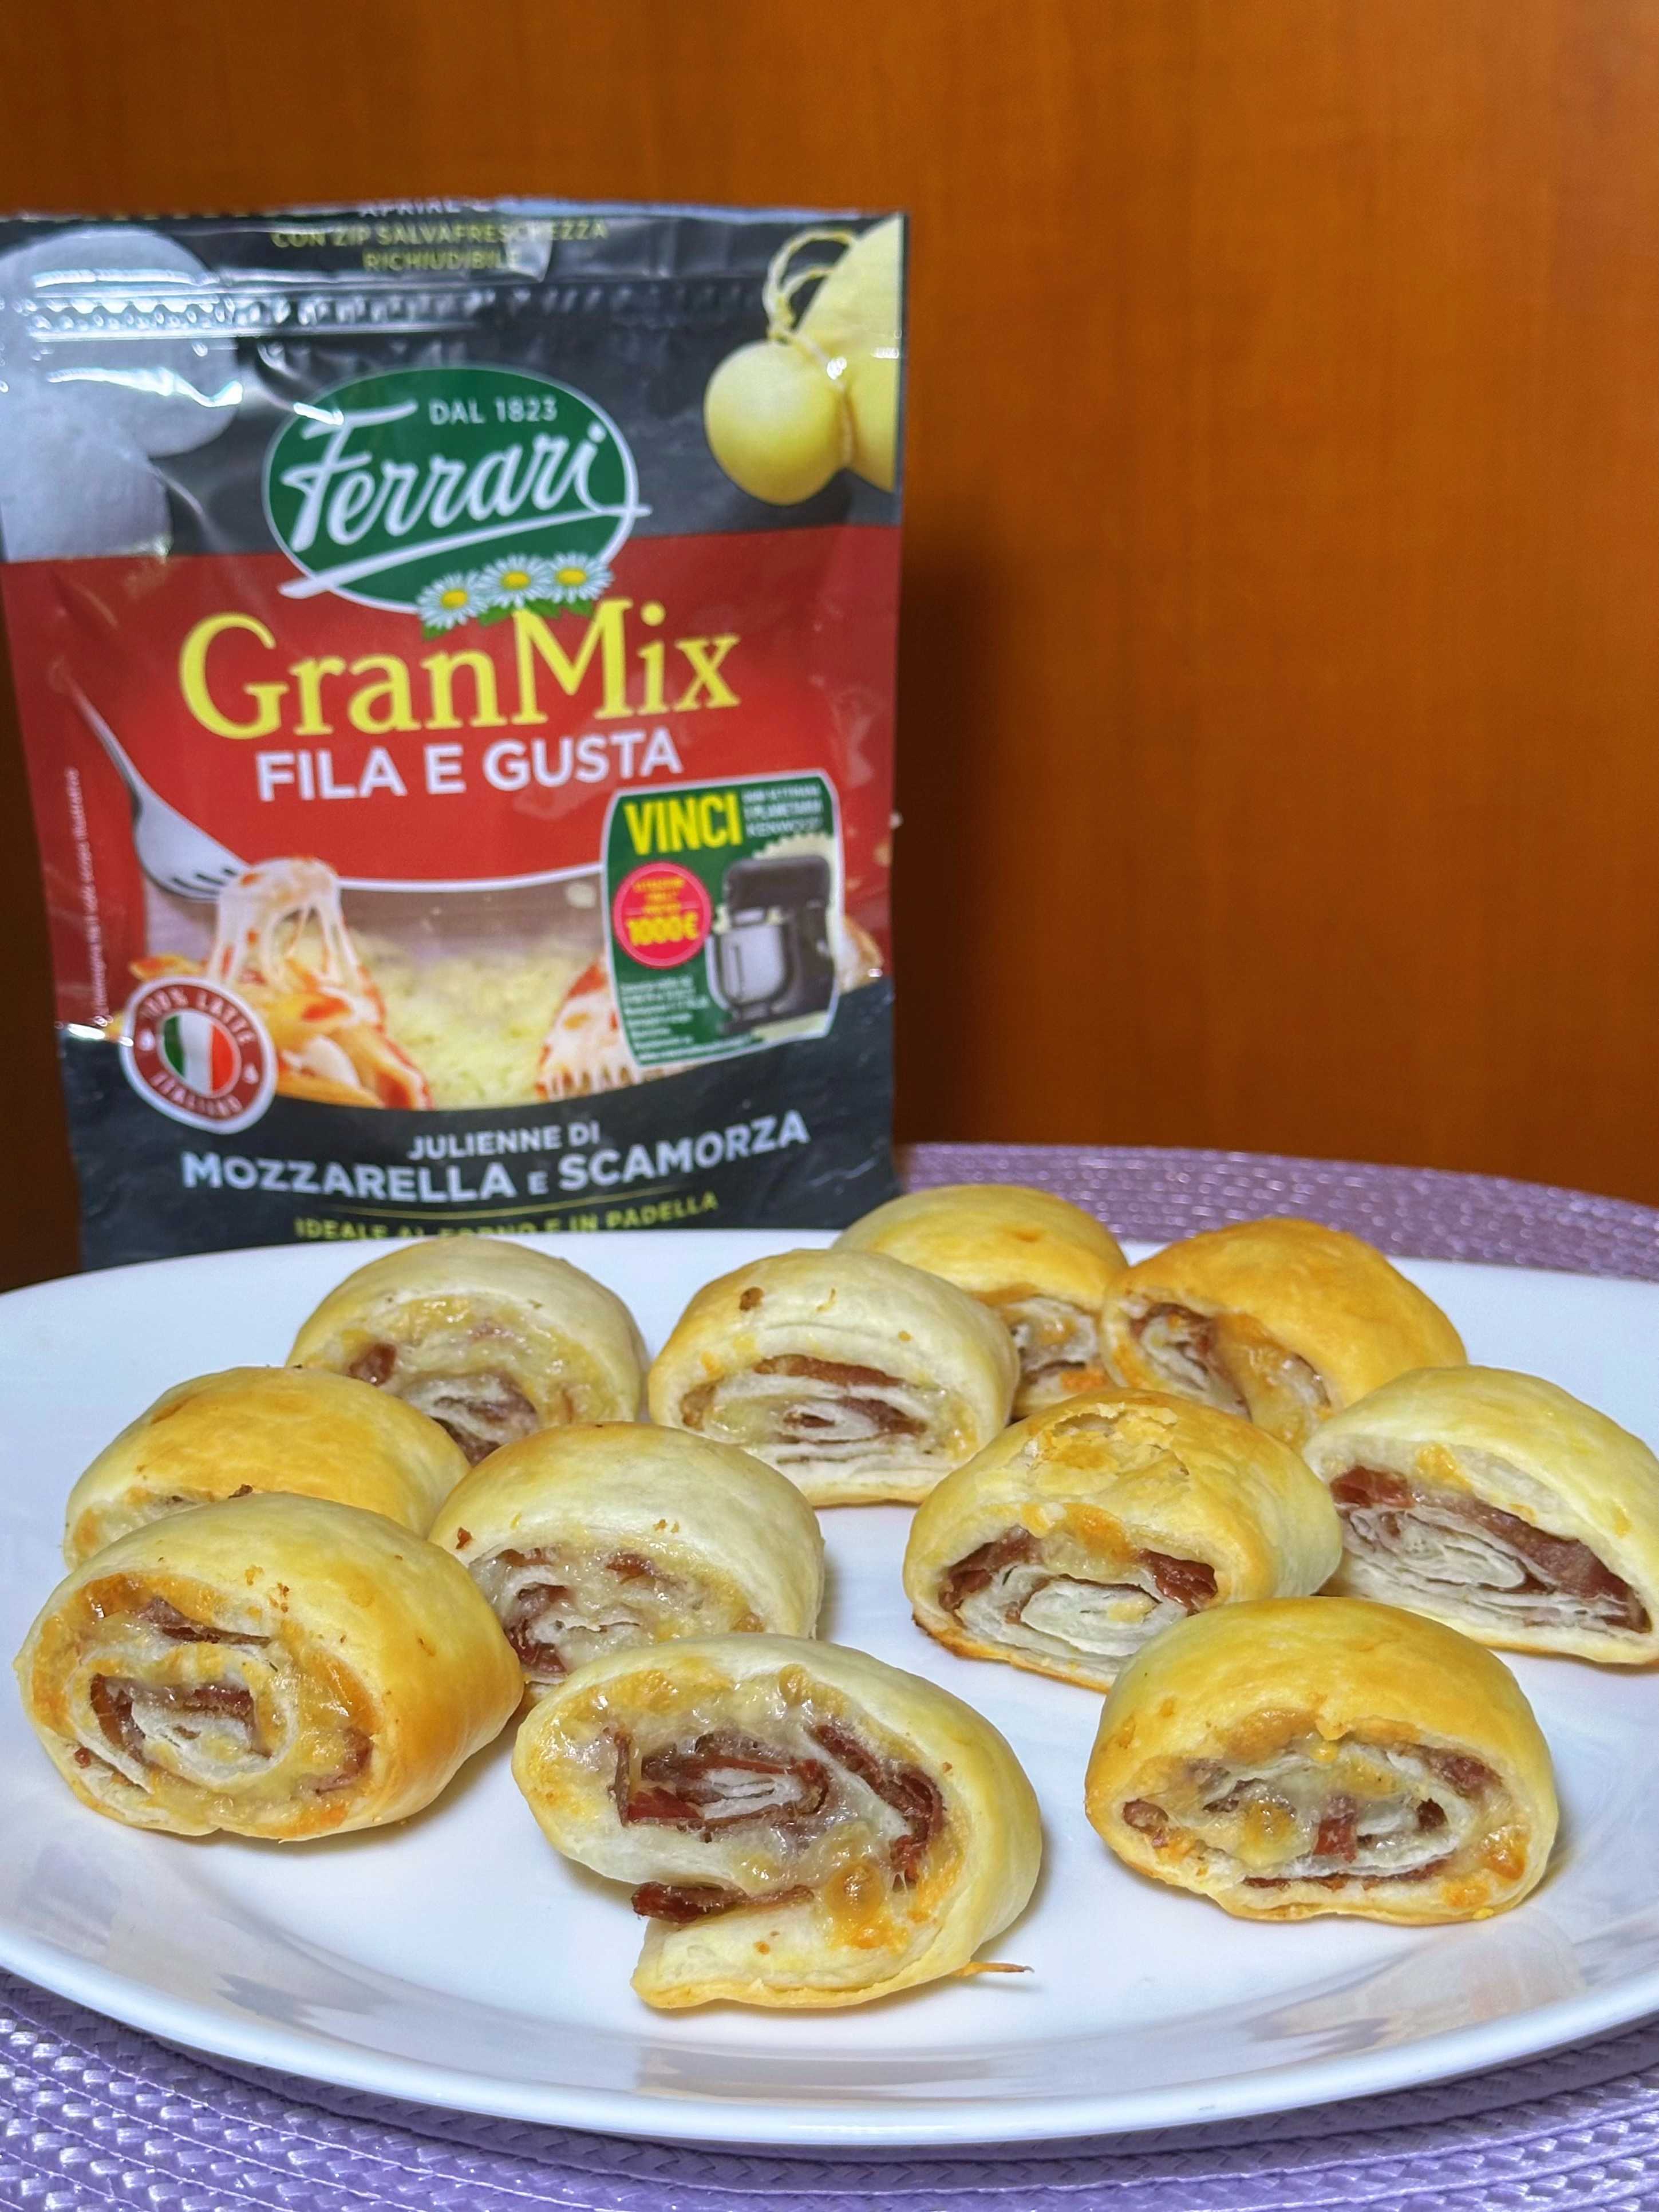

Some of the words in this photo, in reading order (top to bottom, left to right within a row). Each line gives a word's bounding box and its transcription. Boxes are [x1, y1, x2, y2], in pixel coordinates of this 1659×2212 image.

[270, 228, 325, 248] CON
[335, 224, 370, 246] ZIP
[429, 400, 485, 425] DAL
[495, 395, 558, 422] 1823
[279, 401, 635, 567] Ferrari
[178, 598, 742, 741] GranMix
[255, 746, 408, 803] FILA
[424, 743, 467, 795] E
[483, 726, 684, 792] GUSTA
[623, 792, 742, 855] VINCI
[627, 910, 699, 946] 1000€
[180, 1151, 518, 1203] MOZZARELLA
[527, 1170, 549, 1195] E
[558, 1109, 811, 1191] SCAMORZA
[407, 1124, 561, 1160] JULIENNE
[568, 1120, 601, 1146] DI
[294, 1217, 388, 1239] IDEALE
[569, 1214, 599, 1233] IN
[606, 1191, 718, 1229] PADELLA
